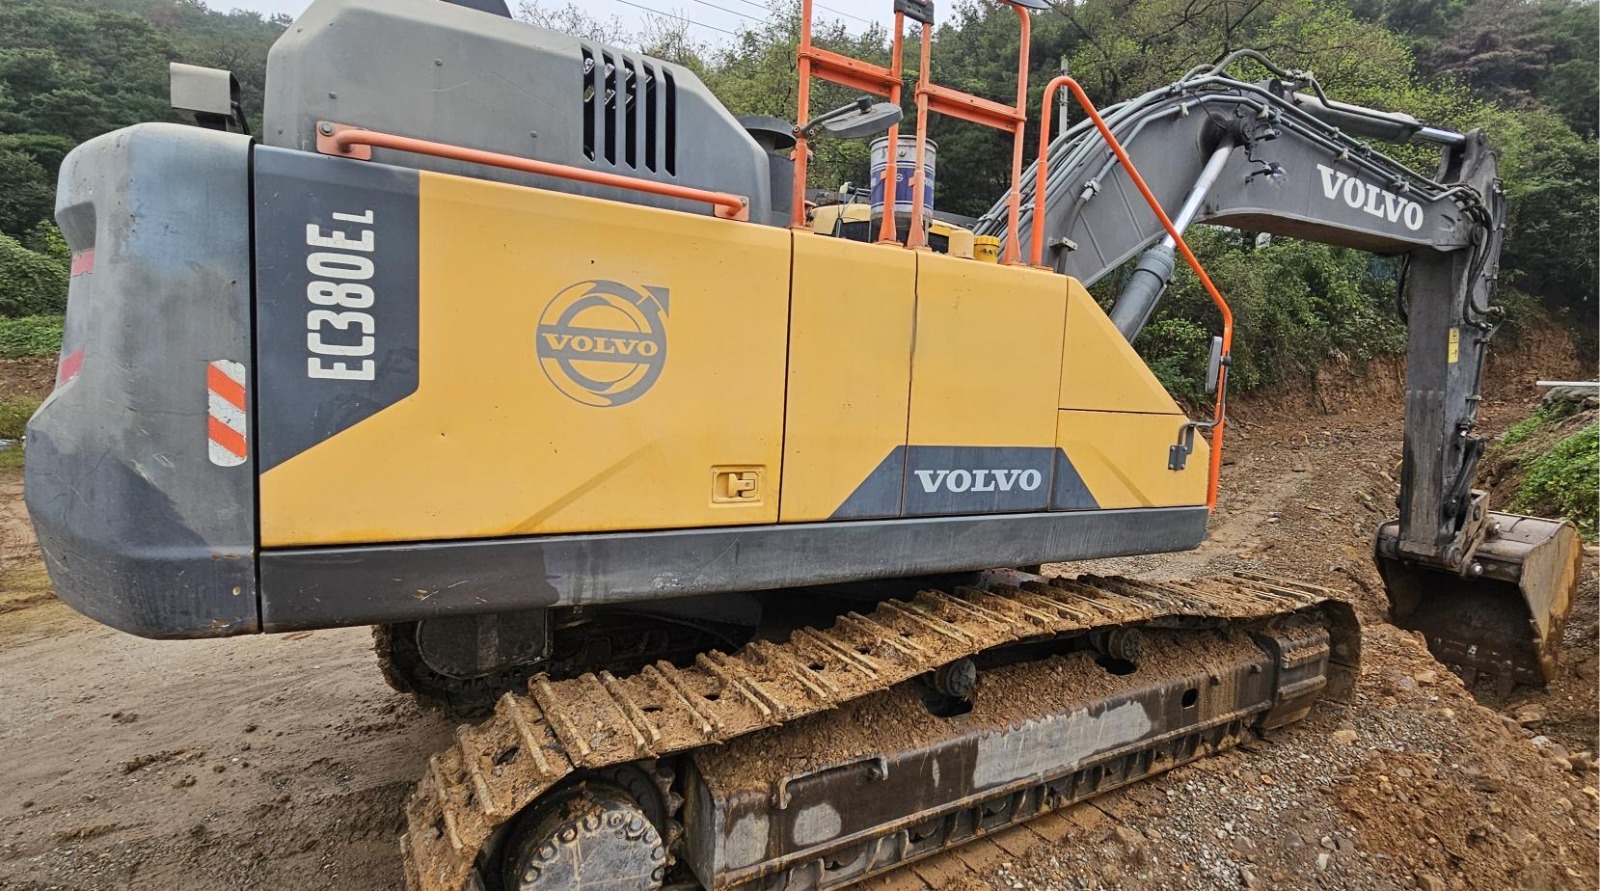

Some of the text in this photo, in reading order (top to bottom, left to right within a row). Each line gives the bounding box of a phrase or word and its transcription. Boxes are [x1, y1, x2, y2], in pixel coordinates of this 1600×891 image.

[1316, 163, 1424, 231] VOLVO
[306, 209, 375, 381] EC380EL
[541, 332, 659, 357] VOLVO
[914, 468, 1042, 493] VOLVO
